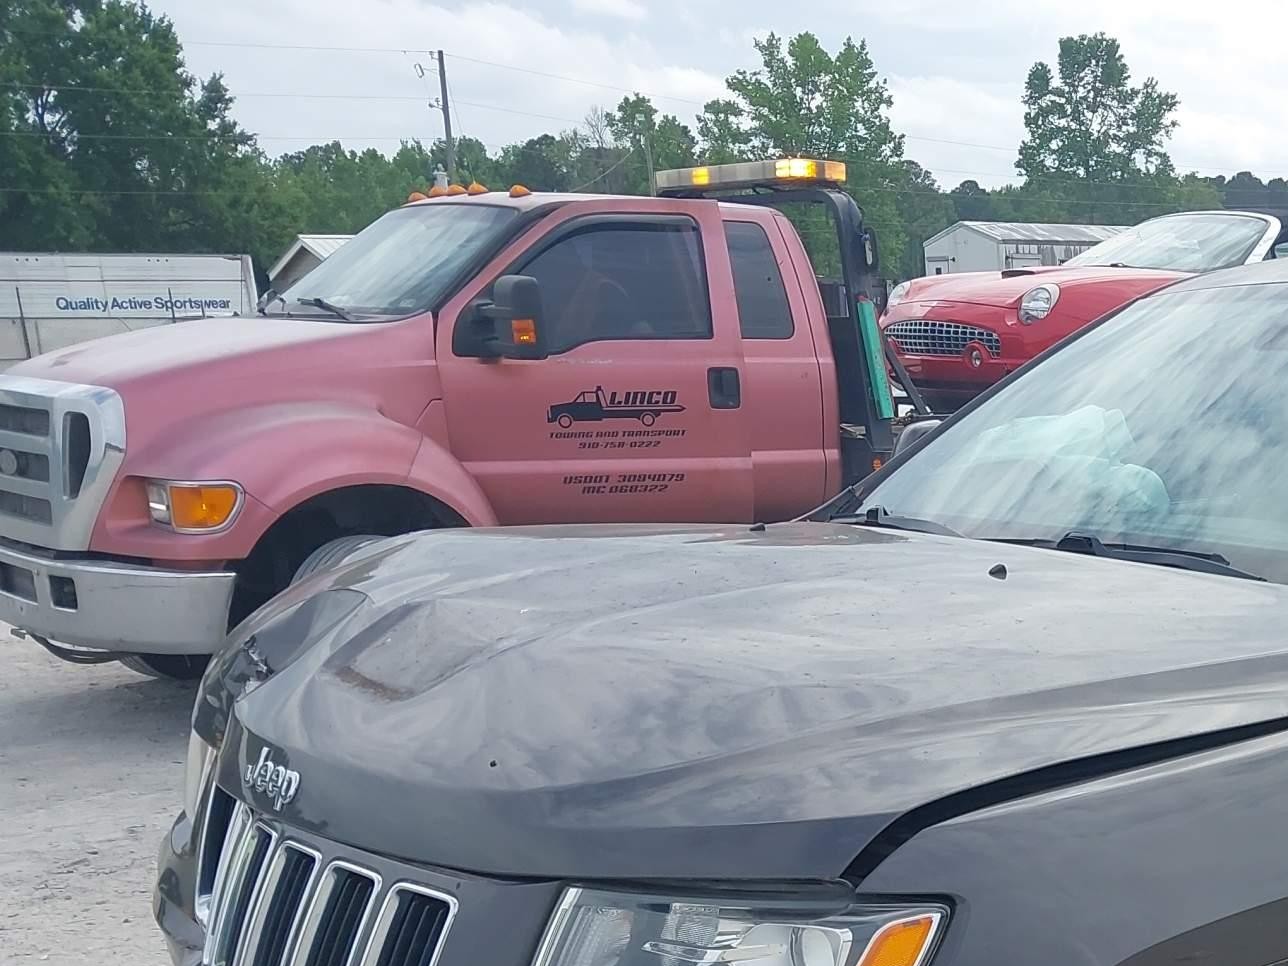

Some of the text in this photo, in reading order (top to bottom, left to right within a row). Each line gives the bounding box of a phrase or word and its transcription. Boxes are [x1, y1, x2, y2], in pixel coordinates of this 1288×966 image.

[56, 297, 231, 312] Quality Active Sportswear
[609, 390, 678, 406] LINCO
[549, 429, 687, 439] TOWING AND TRANSPORT
[562, 475, 610, 485] USDOT
[581, 485, 606, 495] MC
[244, 746, 301, 812] Jeep
